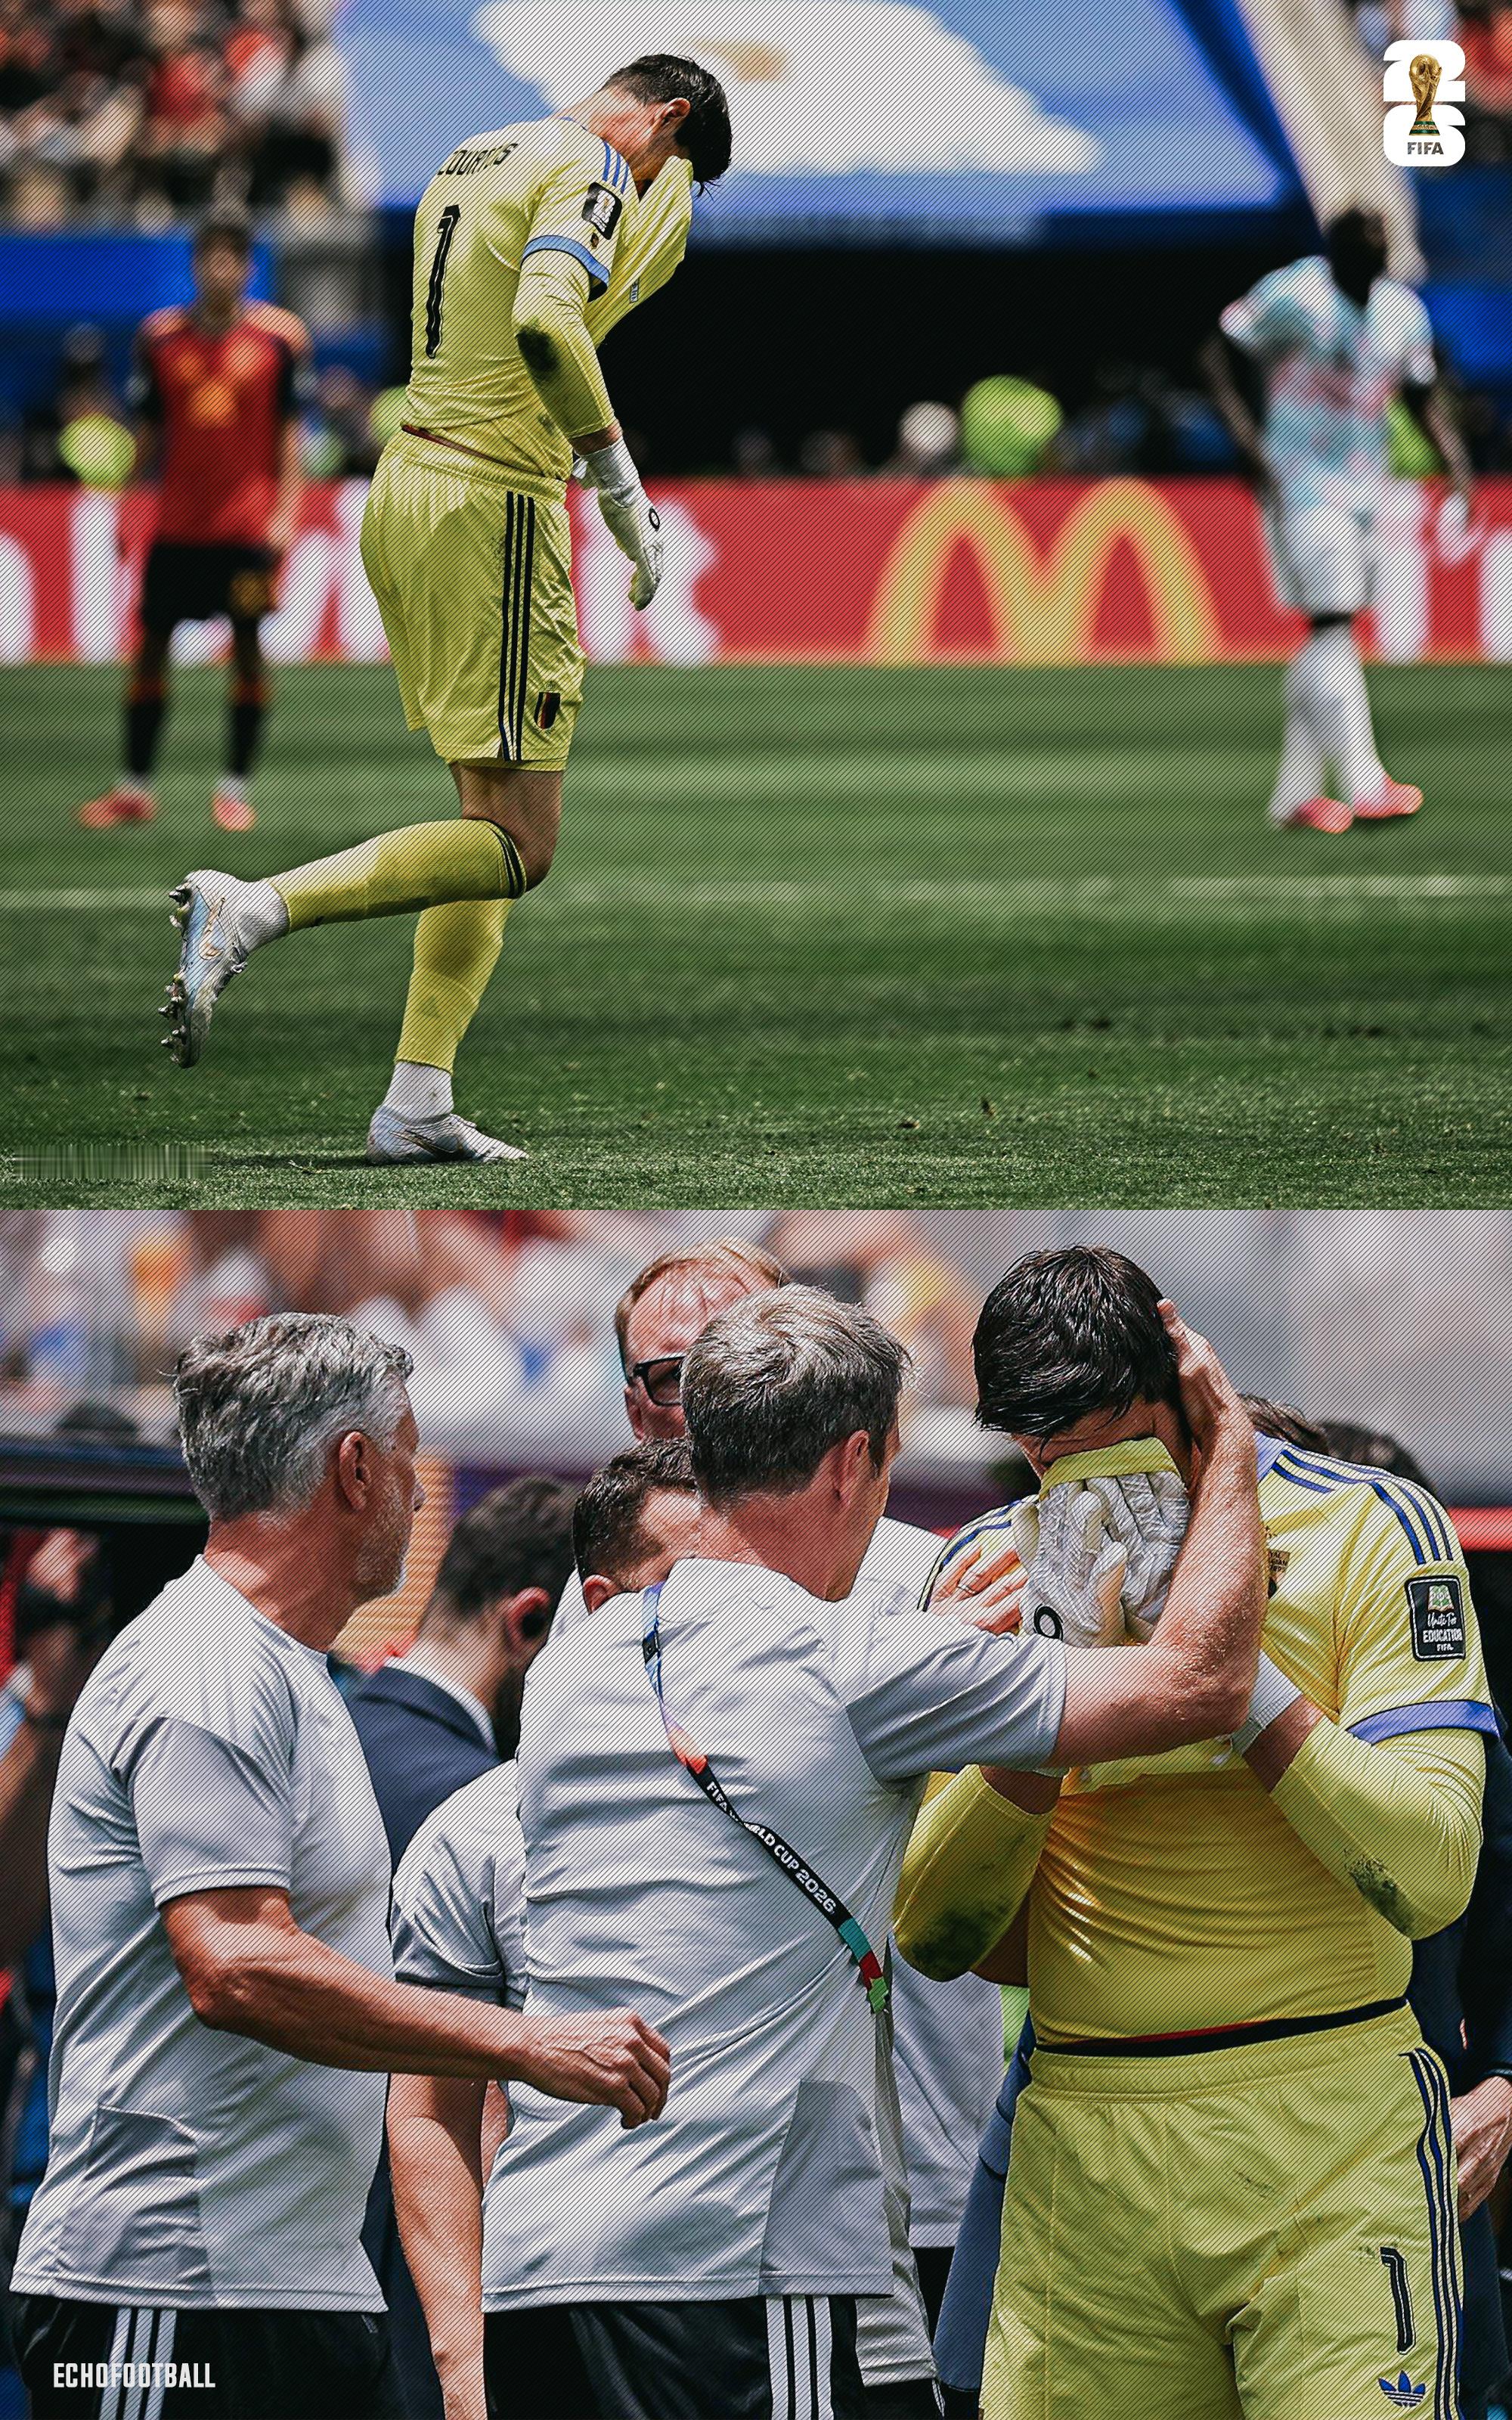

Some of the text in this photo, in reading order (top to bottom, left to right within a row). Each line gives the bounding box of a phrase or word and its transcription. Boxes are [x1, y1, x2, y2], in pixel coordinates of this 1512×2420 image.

[426, 203, 460, 359] 1
[1422, 1627, 1463, 1643] EDUCATION
[1436, 1643, 1455, 1652] FIFA
[706, 1782, 727, 1811] FIFA
[773, 1844, 800, 1870] CUP
[795, 1868, 837, 1913] 2026
[1380, 2246, 1417, 2355] 1
